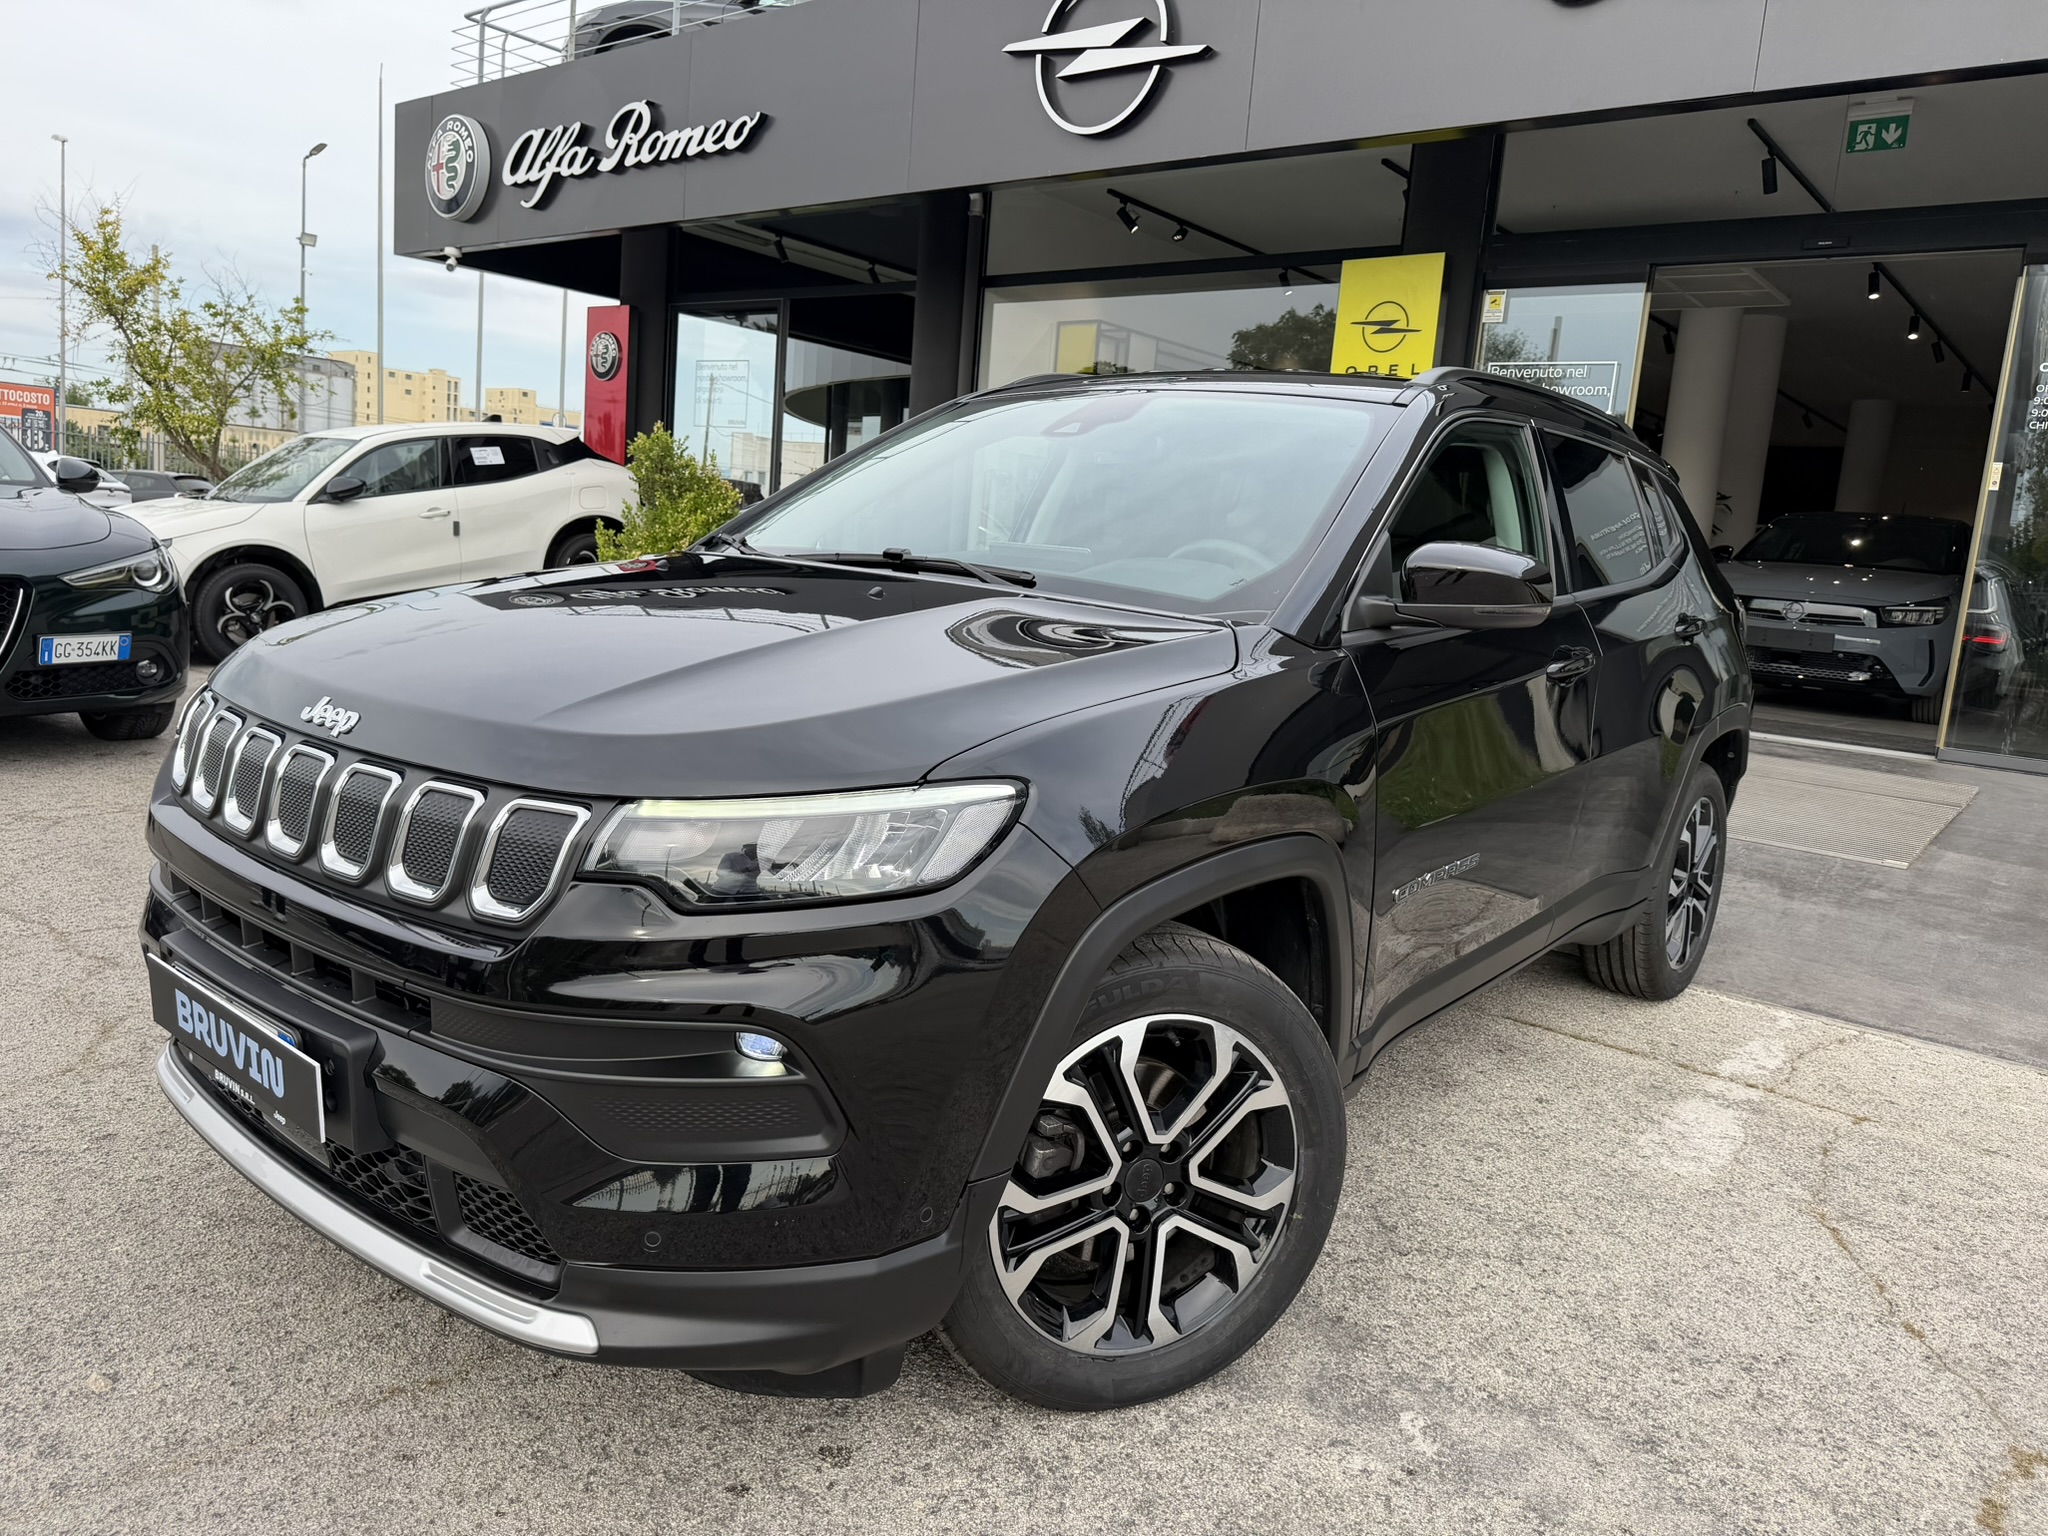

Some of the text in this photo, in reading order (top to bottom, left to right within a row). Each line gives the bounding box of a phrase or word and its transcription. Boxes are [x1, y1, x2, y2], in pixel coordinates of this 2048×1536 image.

[446, 120, 474, 163] ROMEO
[502, 99, 761, 208] Alfa Romeo
[1345, 363, 1420, 377] OPEL
[1490, 364, 1588, 379] Benvenuto nel
[1541, 382, 1611, 398] howroom,
[300, 695, 360, 738] Jeep
[1391, 852, 1481, 904] COMPASS
[174, 987, 286, 1099] BRUVIN
[214, 1068, 241, 1095] BRUVIN
